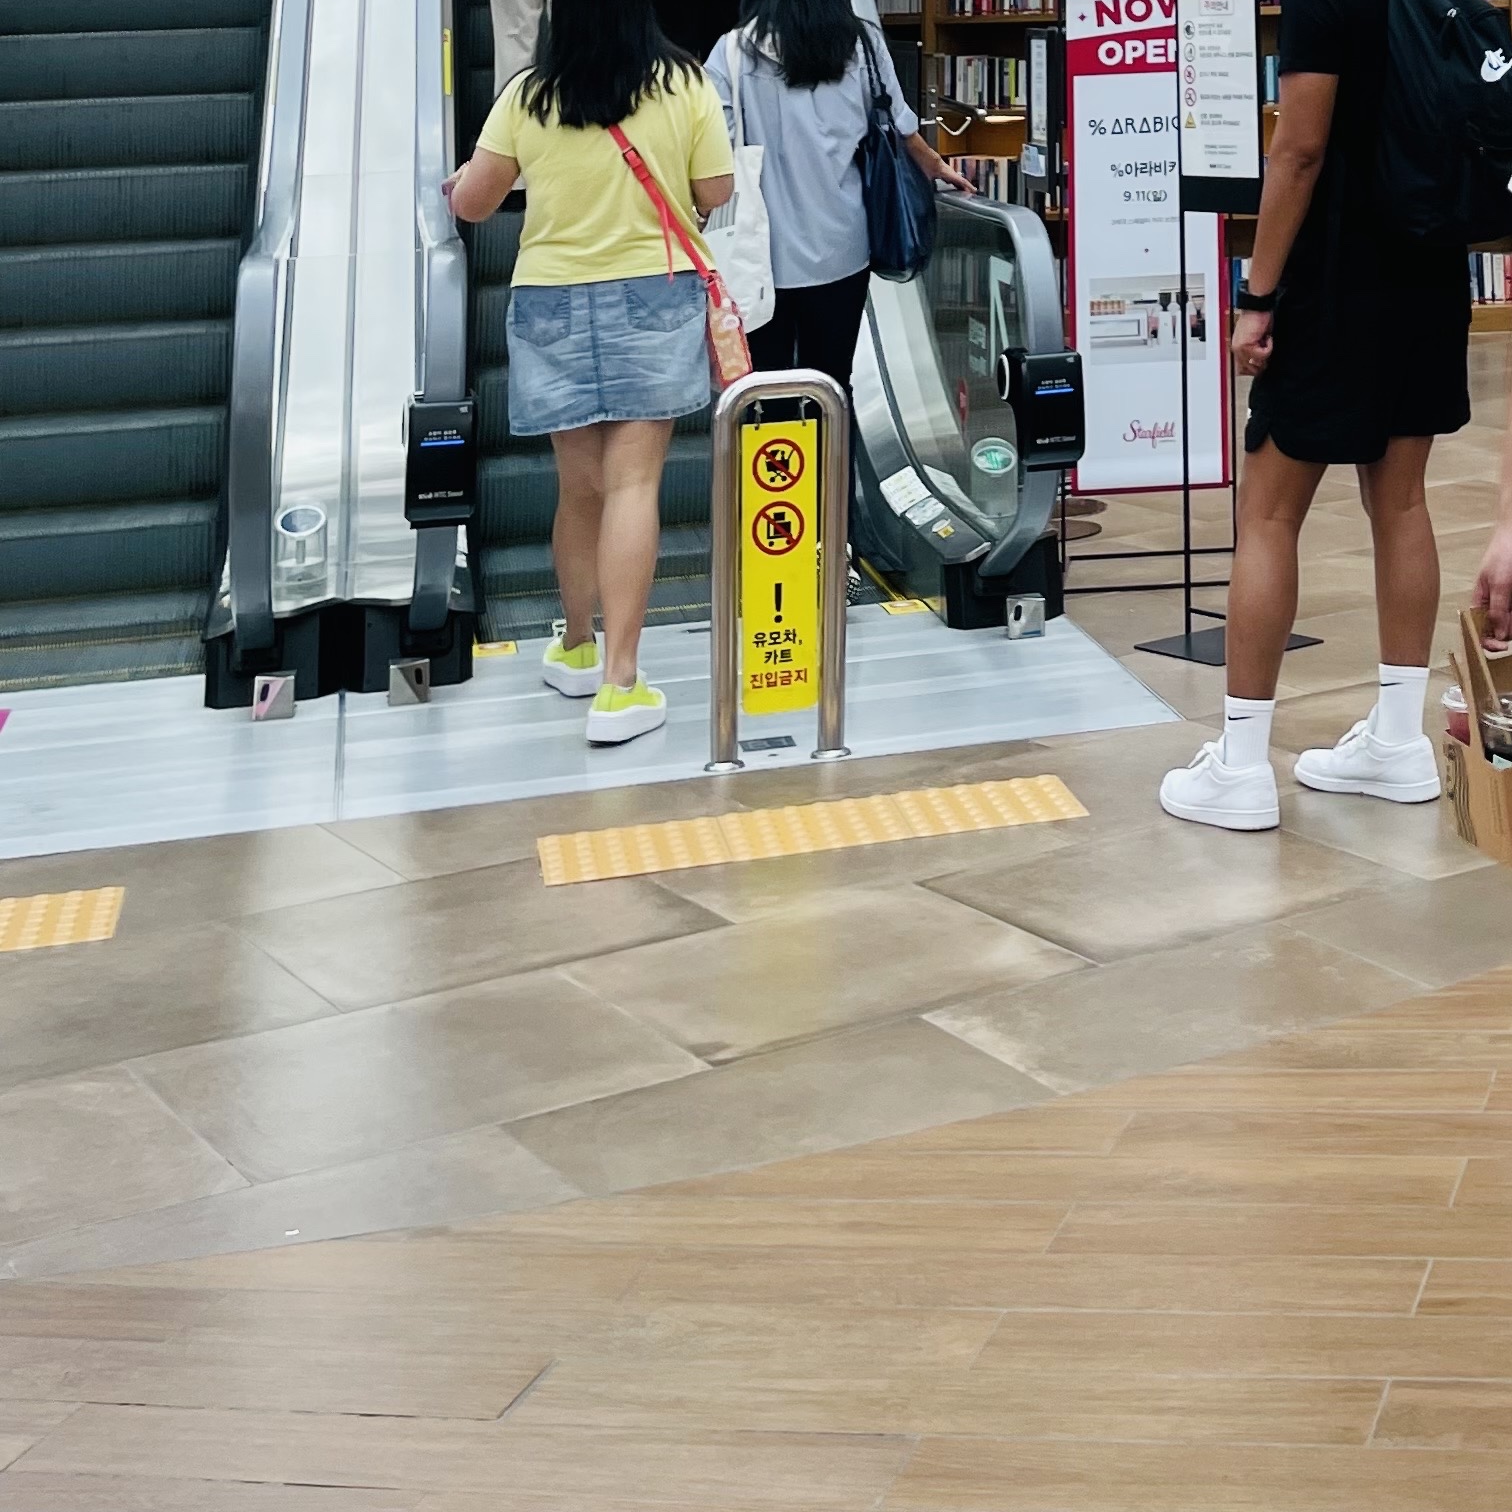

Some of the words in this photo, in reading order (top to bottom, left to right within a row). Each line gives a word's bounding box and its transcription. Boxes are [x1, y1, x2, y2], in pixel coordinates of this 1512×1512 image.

[1123, 419, 1176, 449] Starfield
[752, 629, 803, 647] 유모차,
[763, 649, 792, 665] 카트
[749, 668, 808, 690] 진입금지
